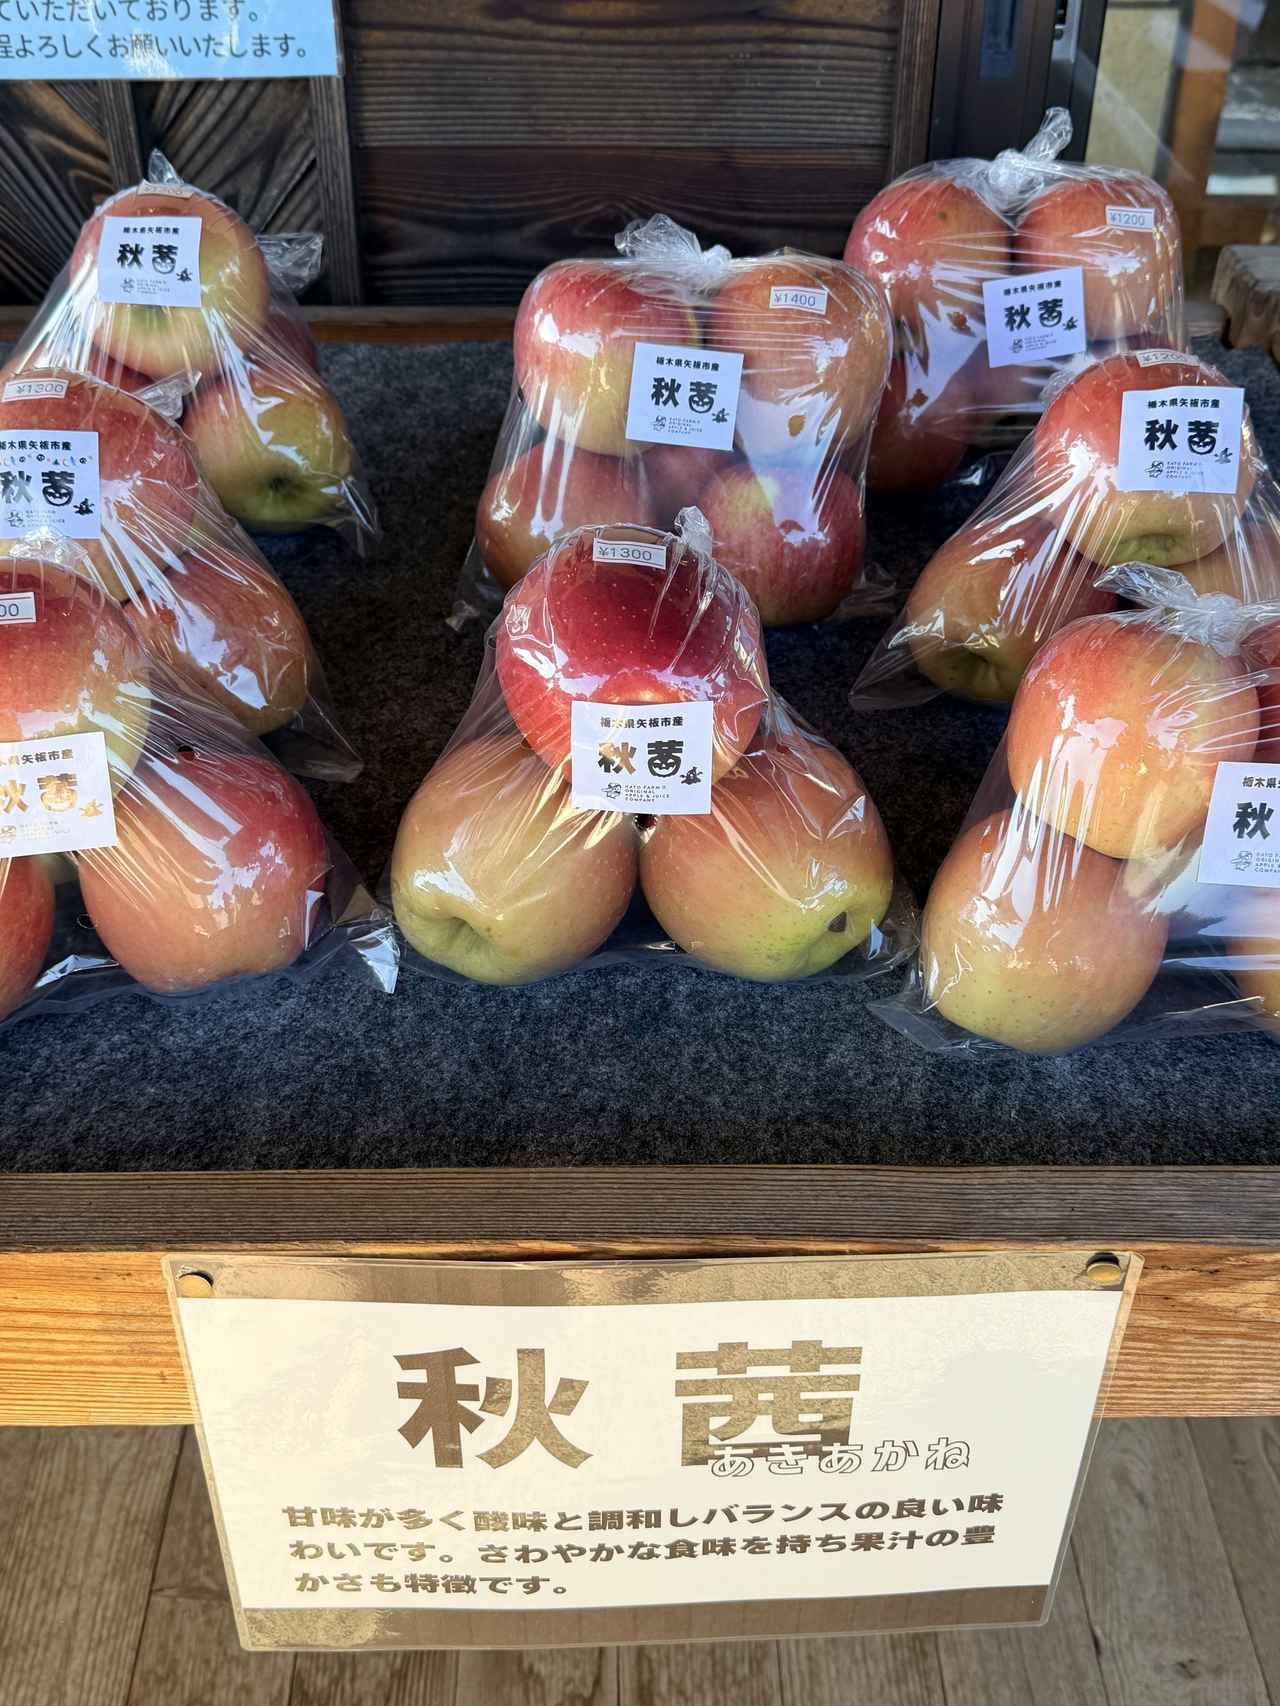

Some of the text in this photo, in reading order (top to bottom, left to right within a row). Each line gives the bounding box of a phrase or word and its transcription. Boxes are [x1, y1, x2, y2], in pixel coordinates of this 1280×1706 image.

[1109, 212, 1145, 226] ¥1200
[774, 293, 816, 307] ¥1400
[16, 383, 64, 394] ¥1300
[599, 546, 652, 561] ¥1300
[598, 739, 684, 778] 秋茜
[1232, 802, 1275, 840] 秋
[709, 1436, 971, 1478] あきあかね
[281, 1492, 1005, 1533] 甘味が多く酸味と調和しバランスの良い味
[294, 1572, 568, 1595] かさも特徴です。
